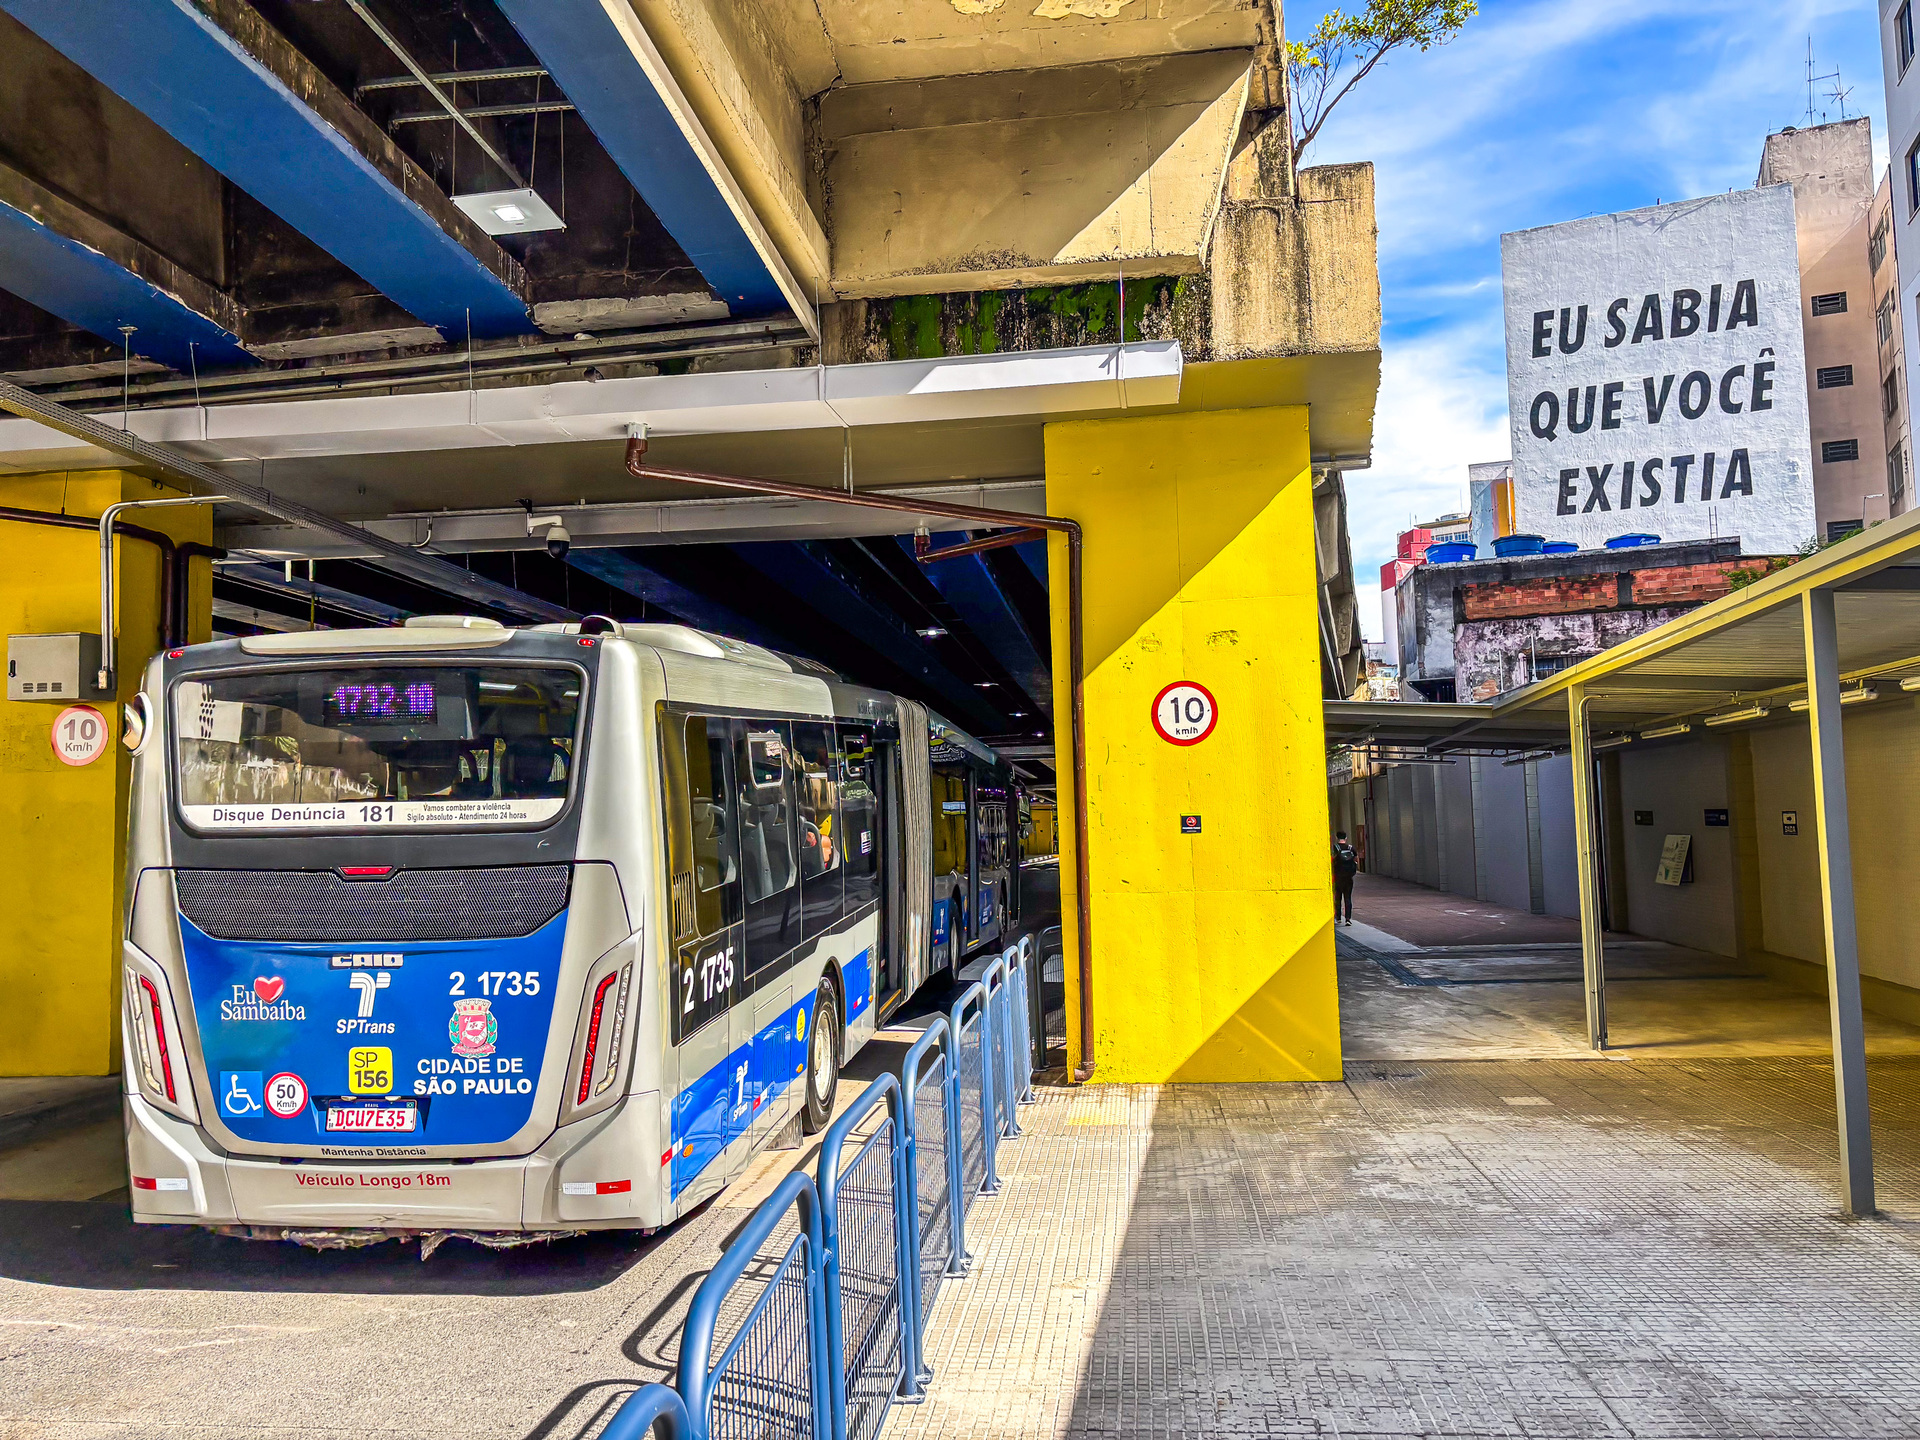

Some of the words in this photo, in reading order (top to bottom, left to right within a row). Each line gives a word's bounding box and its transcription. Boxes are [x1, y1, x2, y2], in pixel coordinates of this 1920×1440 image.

[1532, 304, 1588, 358] EU
[1604, 278, 1759, 348] SABIA
[1529, 381, 1624, 442] QUE
[1642, 347, 1775, 424] VOCÊ
[1556, 448, 1753, 516] EXISTIA
[333, 683, 434, 714] 1732-10
[1170, 696, 1205, 724] 10
[63, 718, 97, 741] 10
[1175, 726, 1199, 736] km/h
[65, 742, 93, 752] Km/h
[213, 808, 265, 824] Disque
[271, 806, 346, 821] Denúncia
[359, 805, 394, 823] 181
[423, 803, 445, 812] Vamos
[446, 803, 476, 812] combater
[483, 802, 512, 811] violência
[407, 813, 425, 823] Sigilo
[426, 812, 454, 822] absoluto
[459, 811, 499, 821] Atendimento
[500, 811, 508, 820] 24
[509, 811, 527, 820] horas
[332, 954, 404, 967] CAIO
[449, 971, 466, 996] 2
[477, 971, 541, 996] 1735
[683, 966, 696, 1015] 2
[700, 946, 734, 1003] 1735
[232, 984, 257, 1005] Eu
[220, 1000, 307, 1021] Sambaíba
[336, 1018, 396, 1034] SPTrans
[354, 1051, 378, 1069] SP
[417, 1058, 491, 1075] CIDADE
[497, 1057, 524, 1073] DE
[354, 1070, 389, 1089] 156
[413, 1075, 457, 1095] SÃO
[463, 1078, 533, 1095] PAULO
[276, 1083, 296, 1099] 50
[276, 1100, 298, 1108] Km/h
[335, 1110, 406, 1127] DCU7E35
[321, 1147, 374, 1157] Mantenha
[376, 1147, 427, 1156] Distância
[295, 1173, 355, 1187] Veículo
[359, 1173, 412, 1189] Longo
[416, 1172, 451, 1186] 18m
